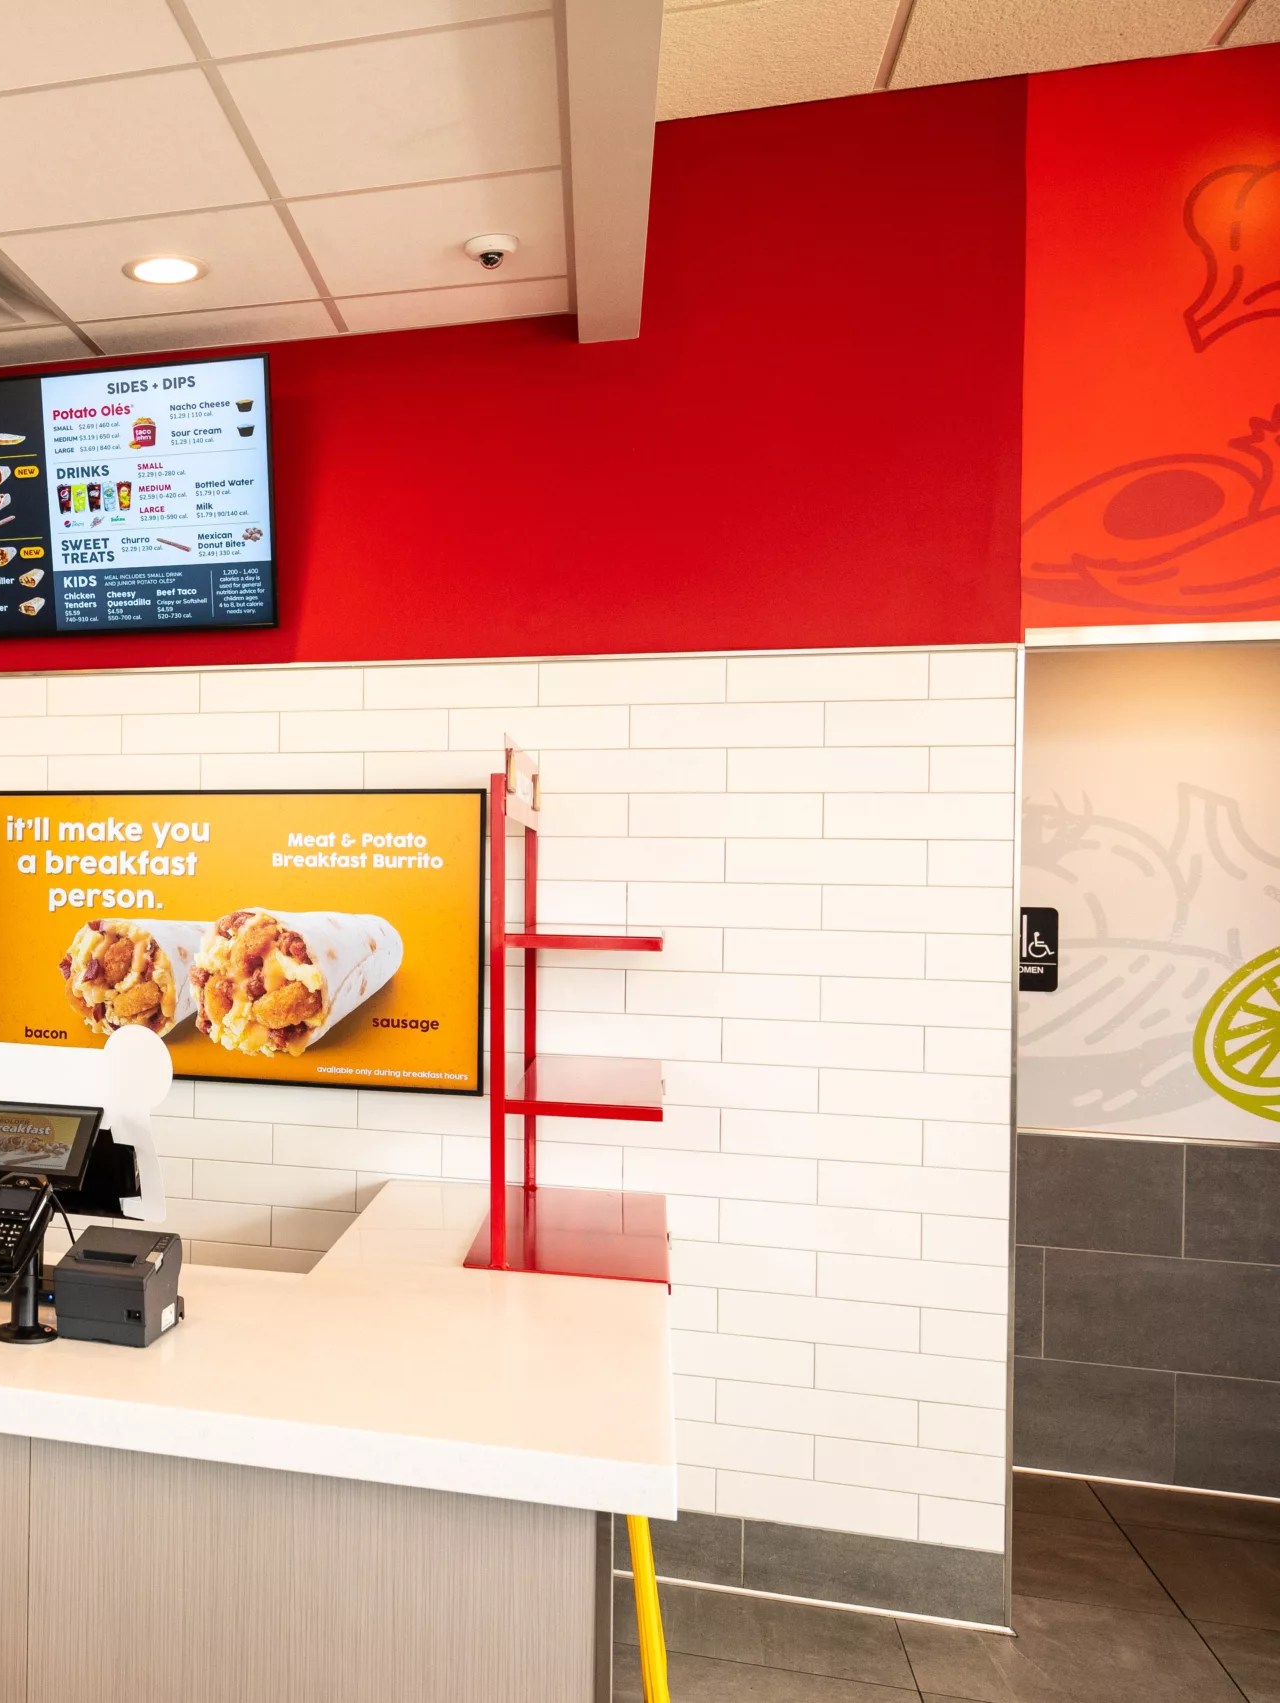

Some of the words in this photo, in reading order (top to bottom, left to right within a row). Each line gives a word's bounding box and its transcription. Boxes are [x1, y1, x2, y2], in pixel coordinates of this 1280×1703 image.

[107, 380, 148, 394] SIDES
[163, 376, 196, 390] DIPS
[170, 402, 197, 411] Nacho
[199, 400, 230, 409] Cheese
[53, 406, 97, 421] Potato
[171, 429, 191, 438] Sour
[193, 427, 222, 436] Cream
[137, 462, 163, 470] SMALL
[57, 465, 110, 480] DRINKS
[139, 484, 171, 493] MEDIUM
[195, 480, 226, 489] Bottled
[228, 478, 254, 487] Water
[121, 537, 150, 545] Churro
[198, 532, 233, 540] Mexican
[62, 538, 109, 552] SWEET
[225, 540, 246, 548] Bites
[62, 551, 115, 564] TREATS
[64, 576, 97, 588] KIDS
[107, 591, 136, 599] Cheesy
[156, 589, 175, 597] Beef
[65, 601, 97, 609] Tenders
[108, 599, 151, 608] Quesadilla
[58, 815, 142, 844] make
[152, 819, 210, 850] you
[287, 832, 336, 848] Meat
[341, 833, 356, 848] &
[361, 832, 426, 849] Potato
[18, 854, 36, 874] a
[45, 850, 198, 876] breakfast
[271, 851, 367, 869] Breakfast
[372, 851, 443, 869] Burrito
[48, 884, 164, 912] person.
[372, 1014, 440, 1032] sausage
[24, 1026, 68, 1040] bacon
[317, 1066, 353, 1076] available
[356, 1067, 372, 1076] only
[374, 1068, 401, 1078] during
[402, 1069, 443, 1079] breakfast
[445, 1072, 468, 1081] hours
